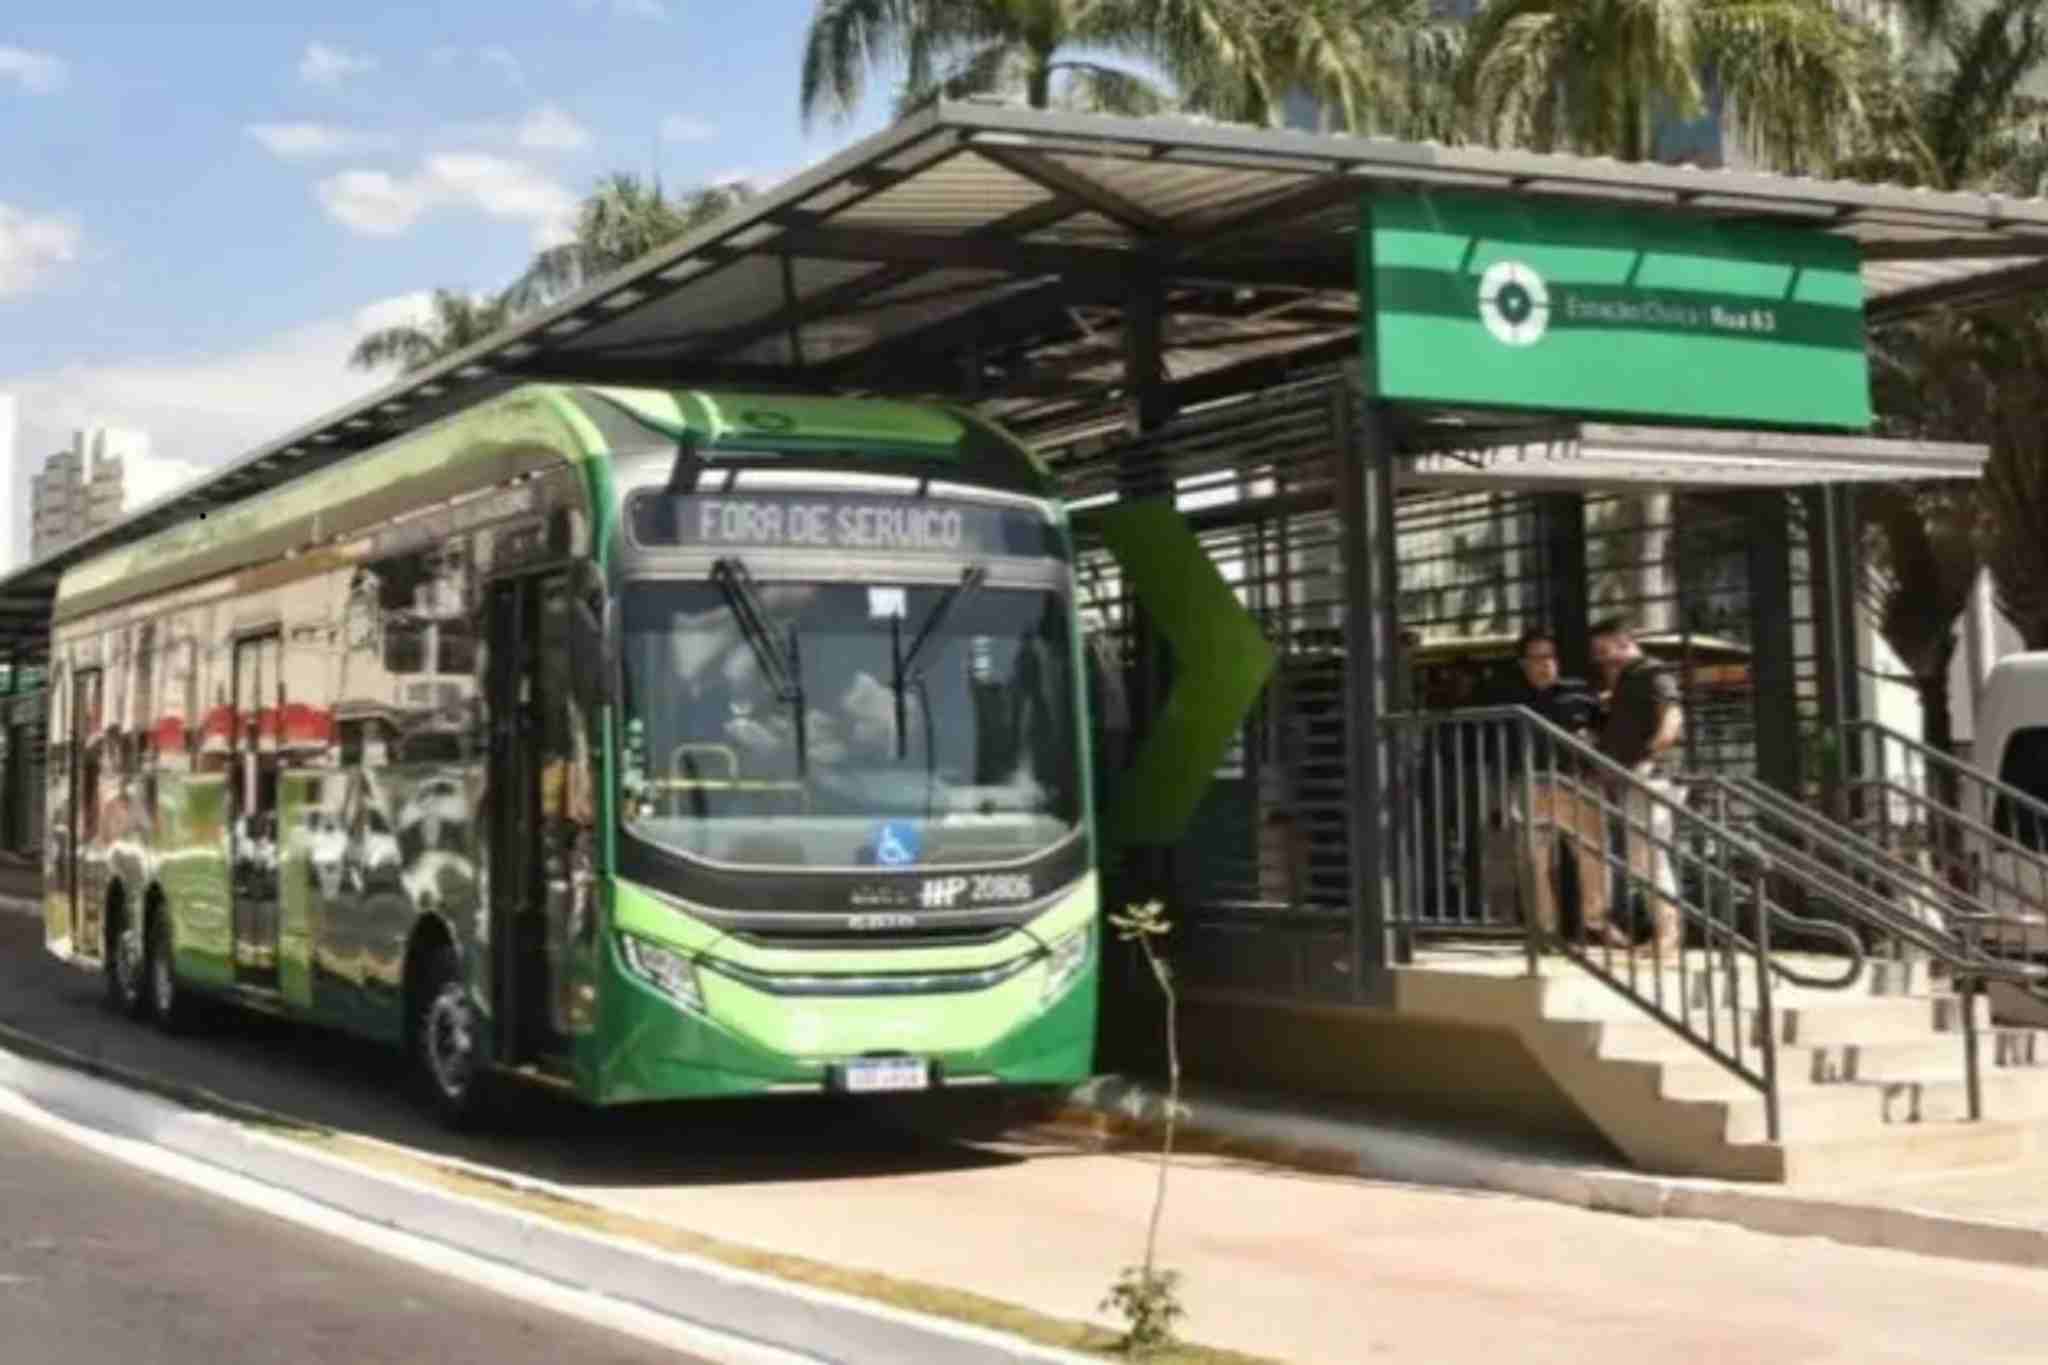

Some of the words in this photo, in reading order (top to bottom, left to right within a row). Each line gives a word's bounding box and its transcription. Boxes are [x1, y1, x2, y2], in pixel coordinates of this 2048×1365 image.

[1710, 305, 1747, 330] Rua
[701, 499, 784, 541] FORA
[787, 505, 831, 544] DE
